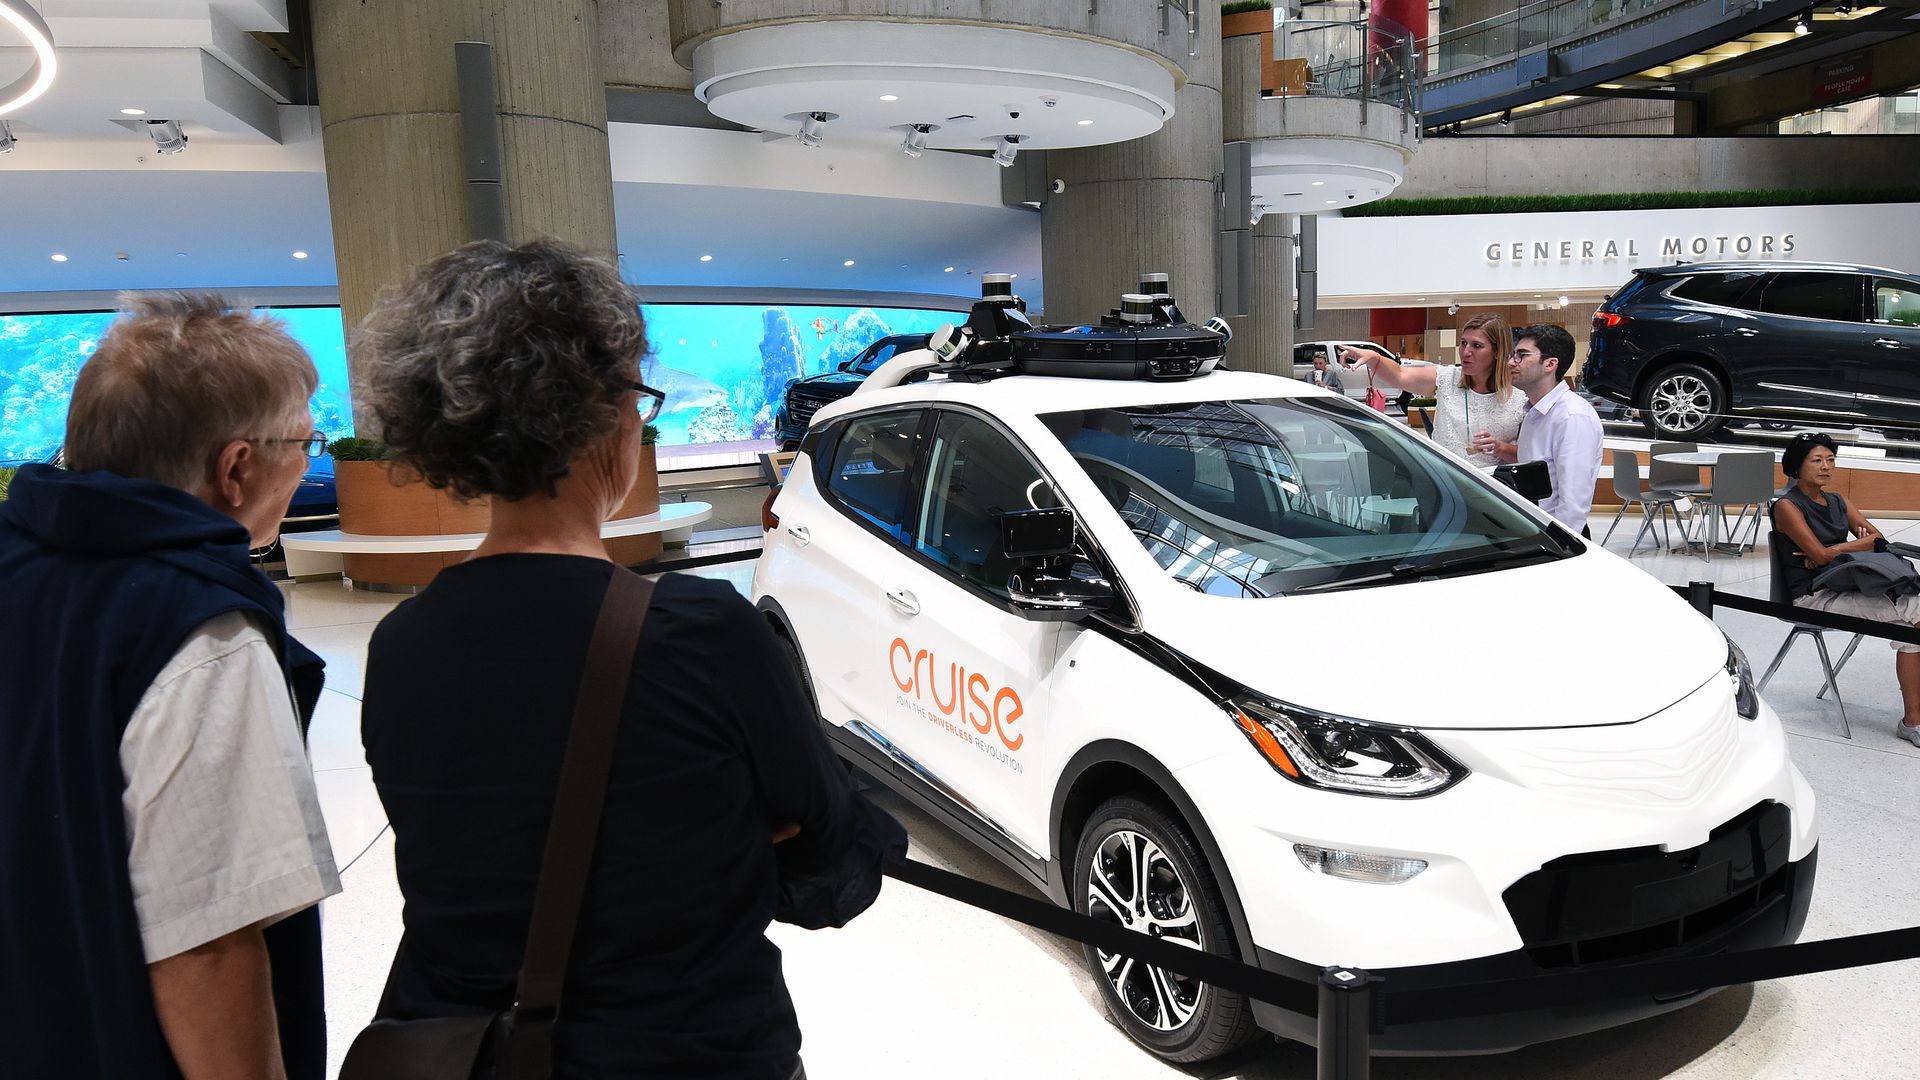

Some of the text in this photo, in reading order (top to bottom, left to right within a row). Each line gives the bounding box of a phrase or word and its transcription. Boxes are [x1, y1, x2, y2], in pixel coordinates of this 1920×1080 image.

[1825, 76, 1865, 92] PEOPLE MOVER
[1828, 64, 1854, 77] PARKING
[1486, 234, 1796, 261] GENERAL MOTORS
[889, 637, 1024, 751] cruise
[897, 694, 1023, 775] JOIN THE DRIVERLESS REVOLUTION
